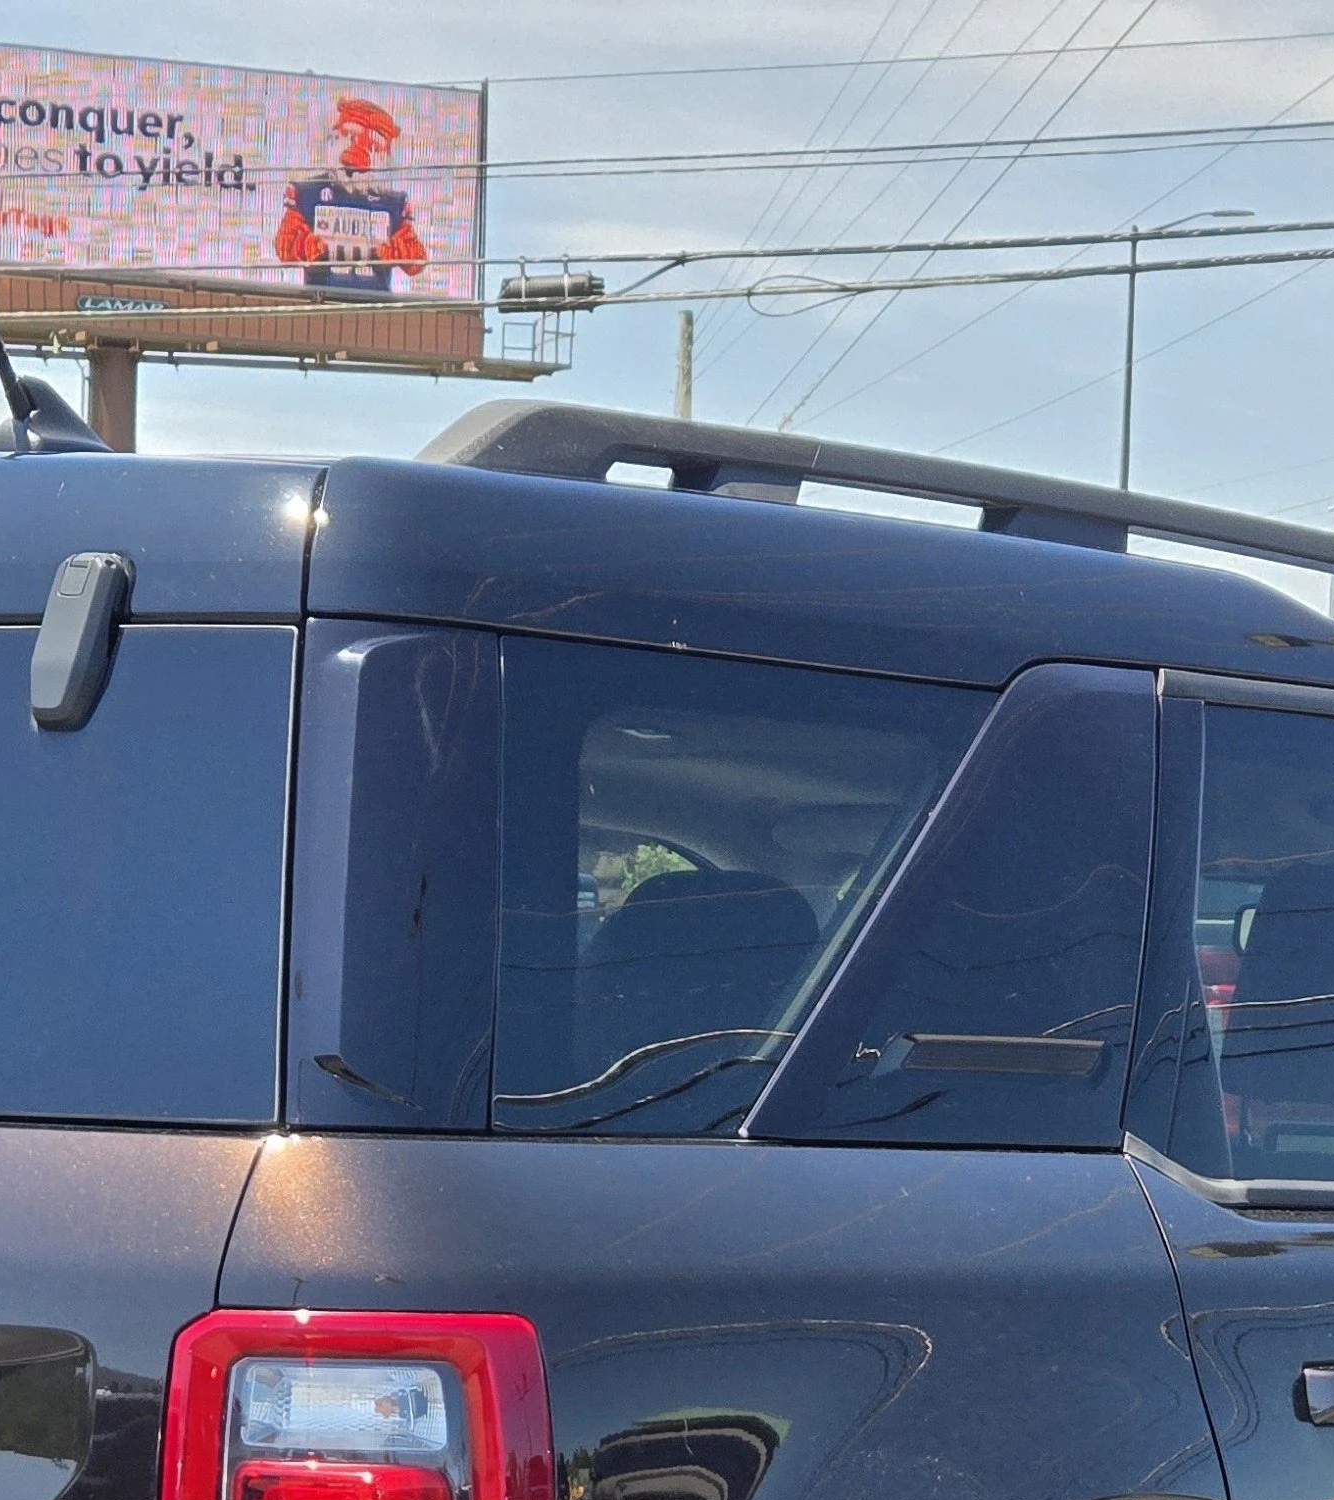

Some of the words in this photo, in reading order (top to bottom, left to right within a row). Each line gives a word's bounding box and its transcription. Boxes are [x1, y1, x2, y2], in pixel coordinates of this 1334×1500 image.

[75, 143, 124, 178] to
[134, 147, 256, 190] yield.
[83, 297, 165, 313] LAMAR
